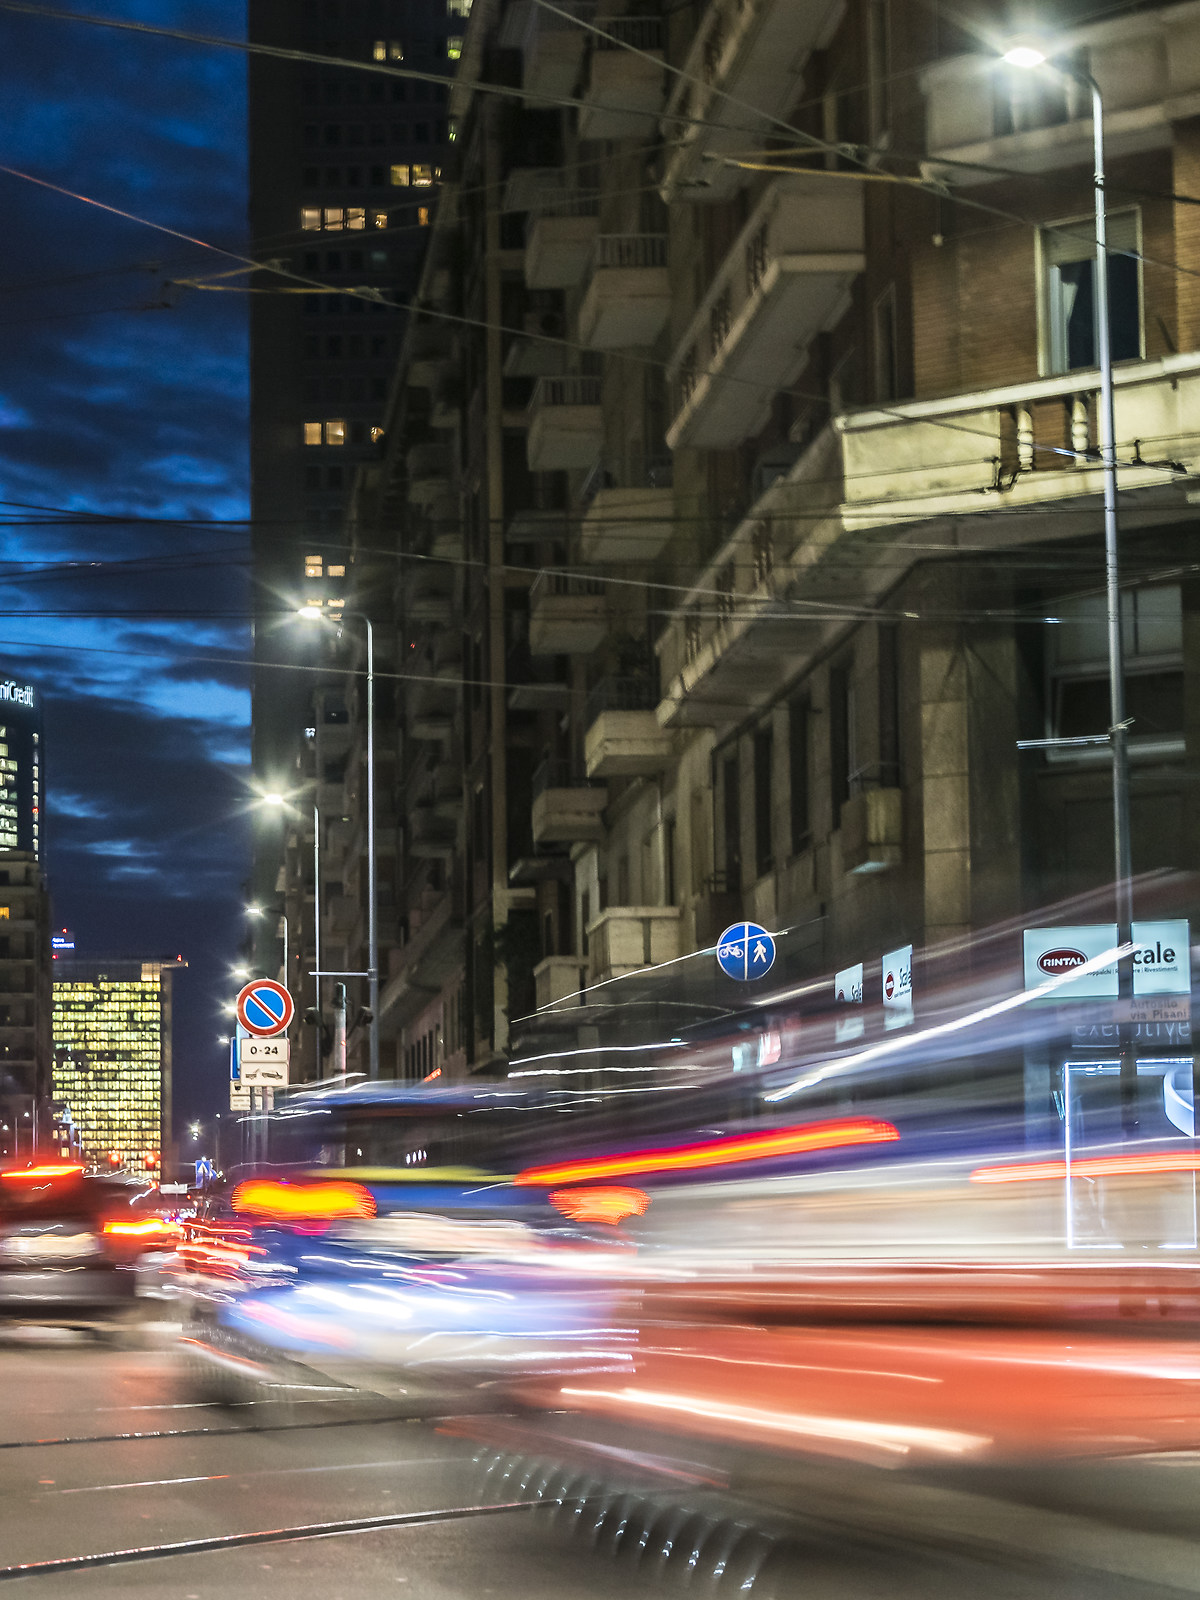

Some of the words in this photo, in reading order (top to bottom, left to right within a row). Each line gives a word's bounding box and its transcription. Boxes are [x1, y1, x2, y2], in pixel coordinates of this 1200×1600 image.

[1133, 942, 1175, 964] cale
[1043, 957, 1083, 967] RINTAL
[1130, 1011, 1147, 1020] via
[1152, 1009, 1186, 1019] Pisani
